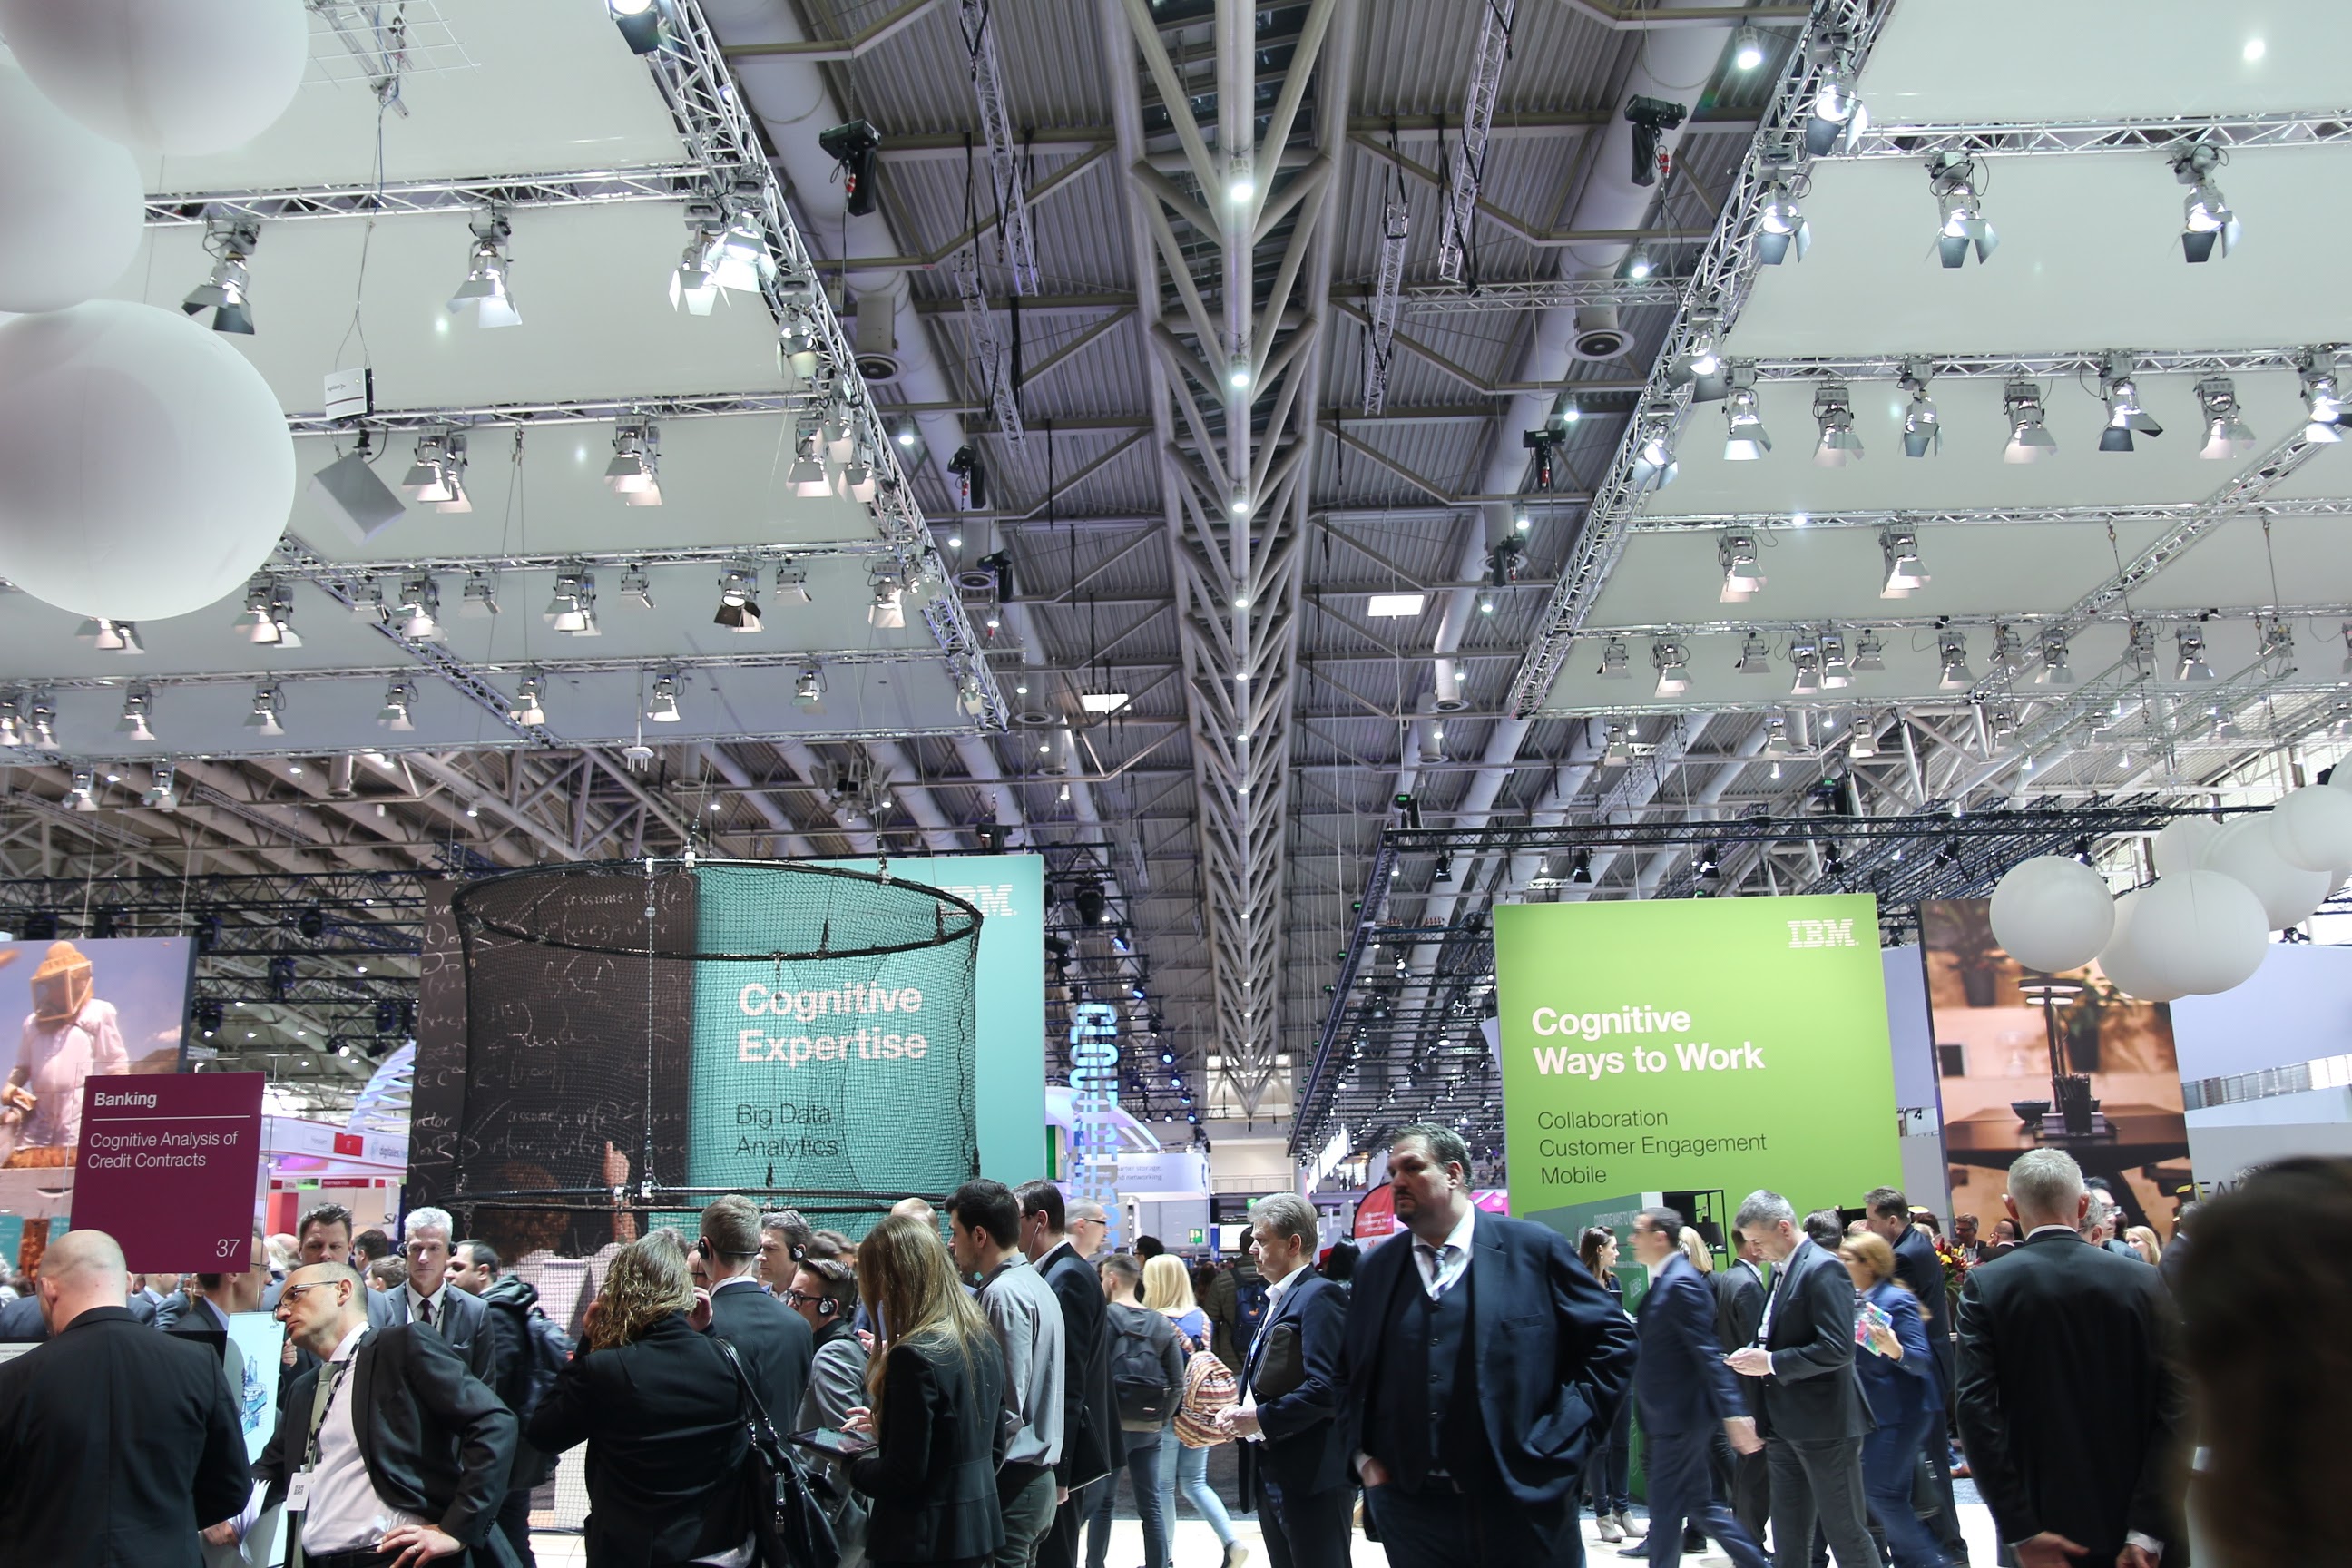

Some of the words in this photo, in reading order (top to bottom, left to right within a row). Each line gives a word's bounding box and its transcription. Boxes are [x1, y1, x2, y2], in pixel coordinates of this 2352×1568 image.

[1786, 918, 1855, 948] IBM
[739, 980, 924, 1022] Cognitive
[1532, 1004, 1691, 1042] Cognitive
[739, 1026, 929, 1069] Expertise
[1069, 1003, 1120, 1112] CLOUD
[1533, 1045, 1625, 1081] Ways
[1632, 1045, 1668, 1073] to
[1673, 1041, 1767, 1072] Work
[93, 1091, 158, 1109] Banking
[736, 1103, 772, 1129] Big
[780, 1103, 831, 1124] Data
[1537, 1109, 1669, 1130] Collaboration
[90, 1132, 157, 1152] Cognitive
[160, 1131, 220, 1149] Analysis
[223, 1131, 239, 1145] of
[735, 1136, 839, 1161] Analytics
[1539, 1138, 1636, 1157] Customer
[1642, 1133, 1768, 1158] Engagement
[87, 1153, 132, 1169] Credit
[135, 1152, 207, 1168] Contracts
[1541, 1165, 1607, 1185] Mobile
[215, 1239, 240, 1258] 37
